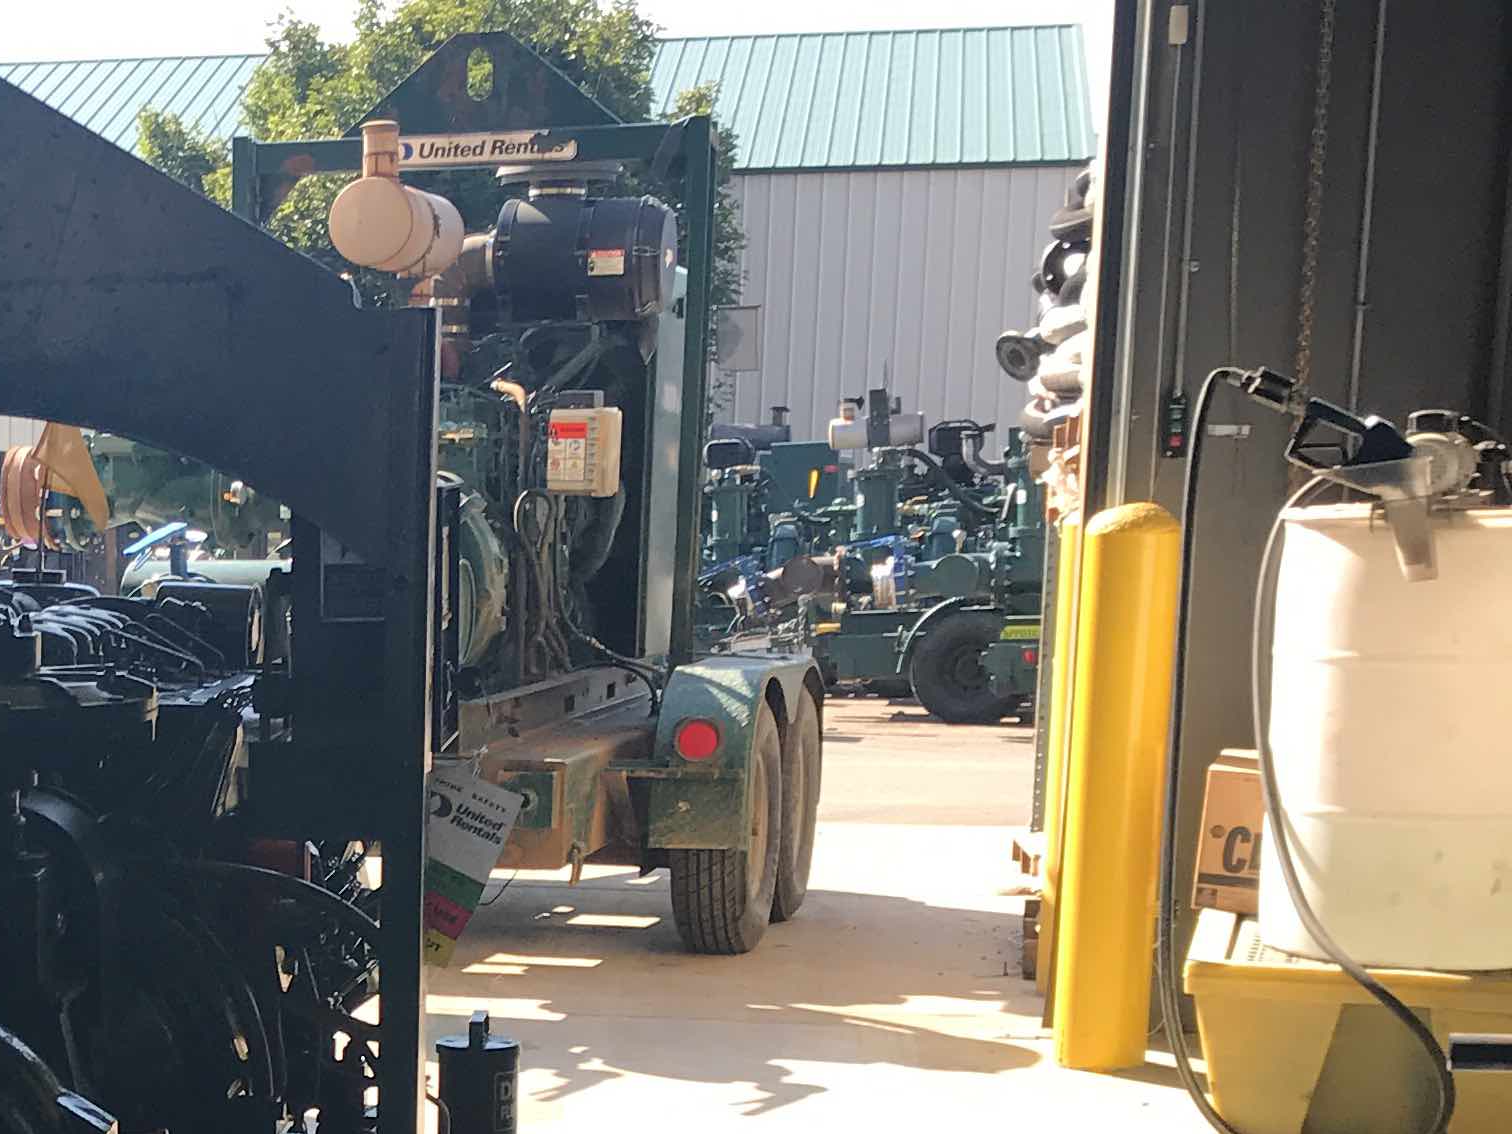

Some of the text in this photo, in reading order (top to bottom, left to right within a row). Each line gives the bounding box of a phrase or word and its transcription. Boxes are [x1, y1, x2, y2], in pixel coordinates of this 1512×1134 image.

[419, 140, 486, 159] United
[450, 815, 502, 845] Rentals
[455, 803, 505, 832] United
